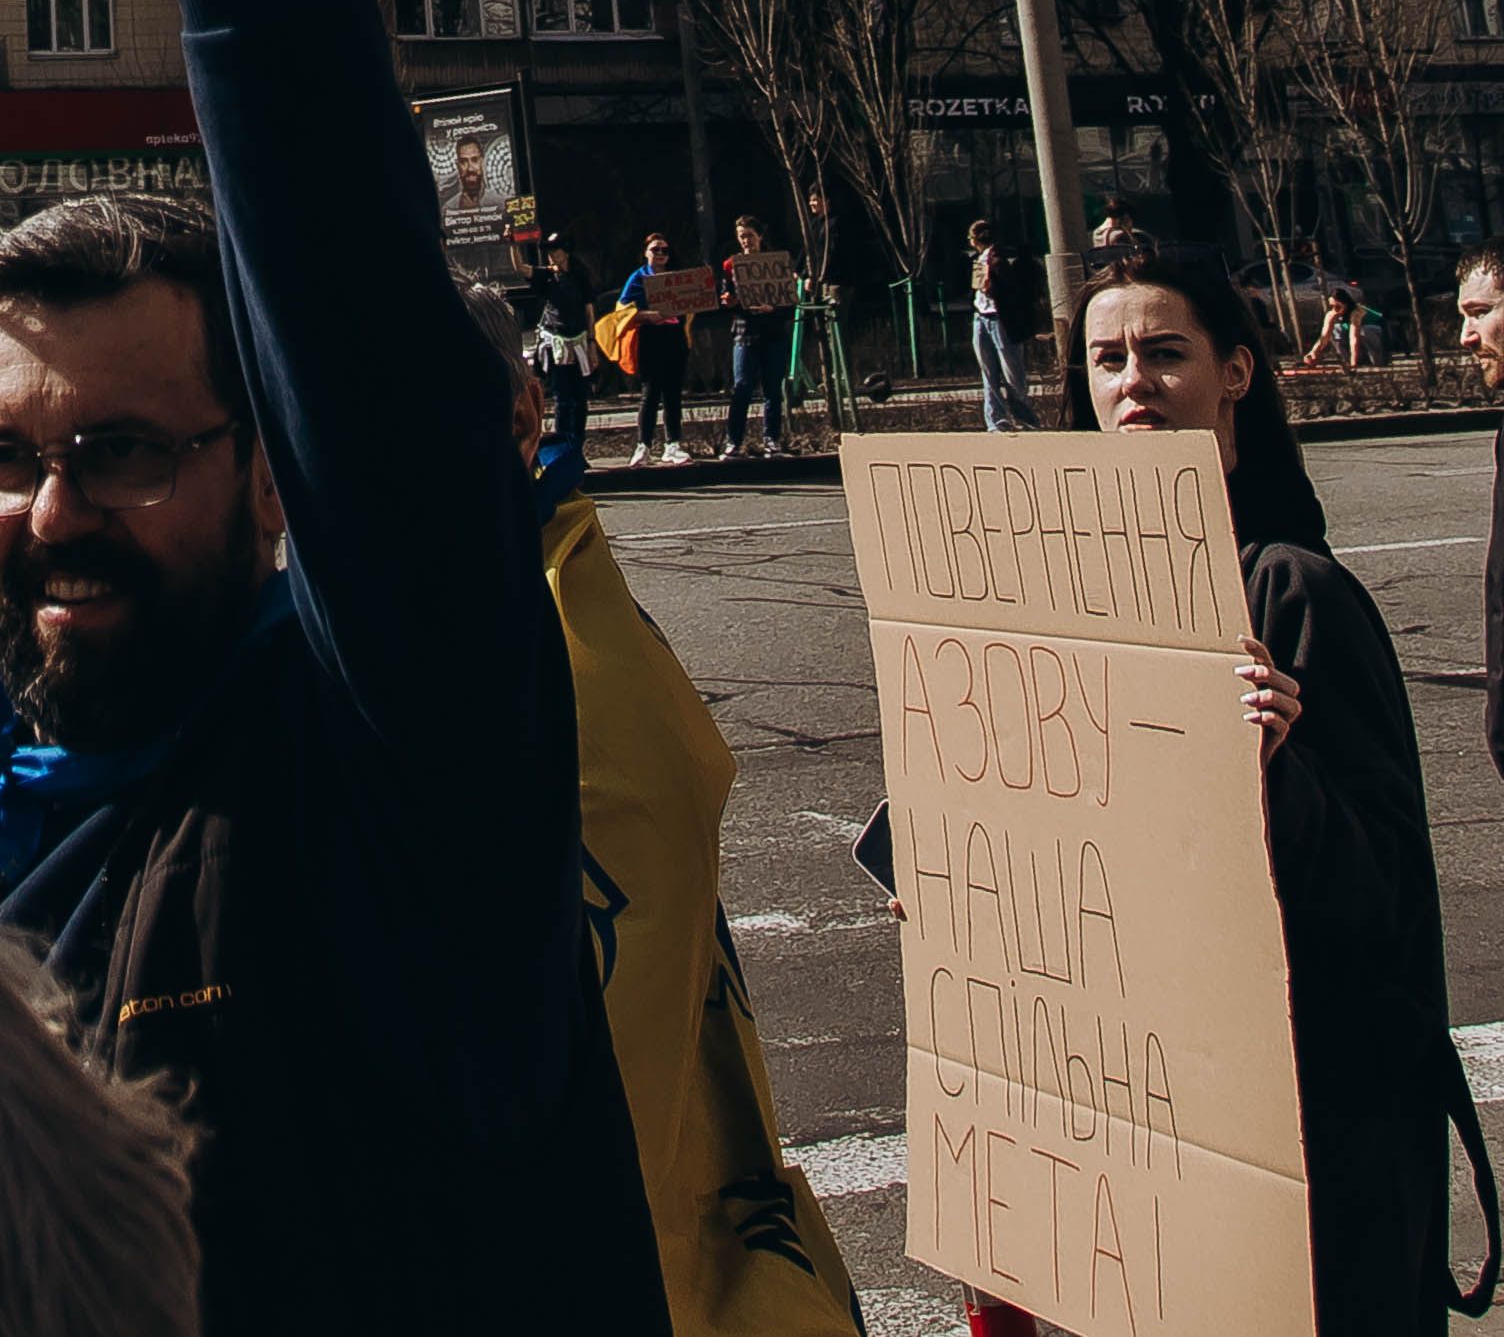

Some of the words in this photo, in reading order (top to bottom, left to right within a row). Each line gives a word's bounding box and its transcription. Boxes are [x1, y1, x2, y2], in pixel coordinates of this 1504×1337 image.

[909, 98, 1030, 116] ROZETKA
[868, 462, 1223, 638] ПОВЕРНЕННЯ
[900, 633, 1112, 809] АЗОВУ
[908, 807, 1126, 999] НАША
[930, 966, 1182, 1182] СПІЛЬНА
